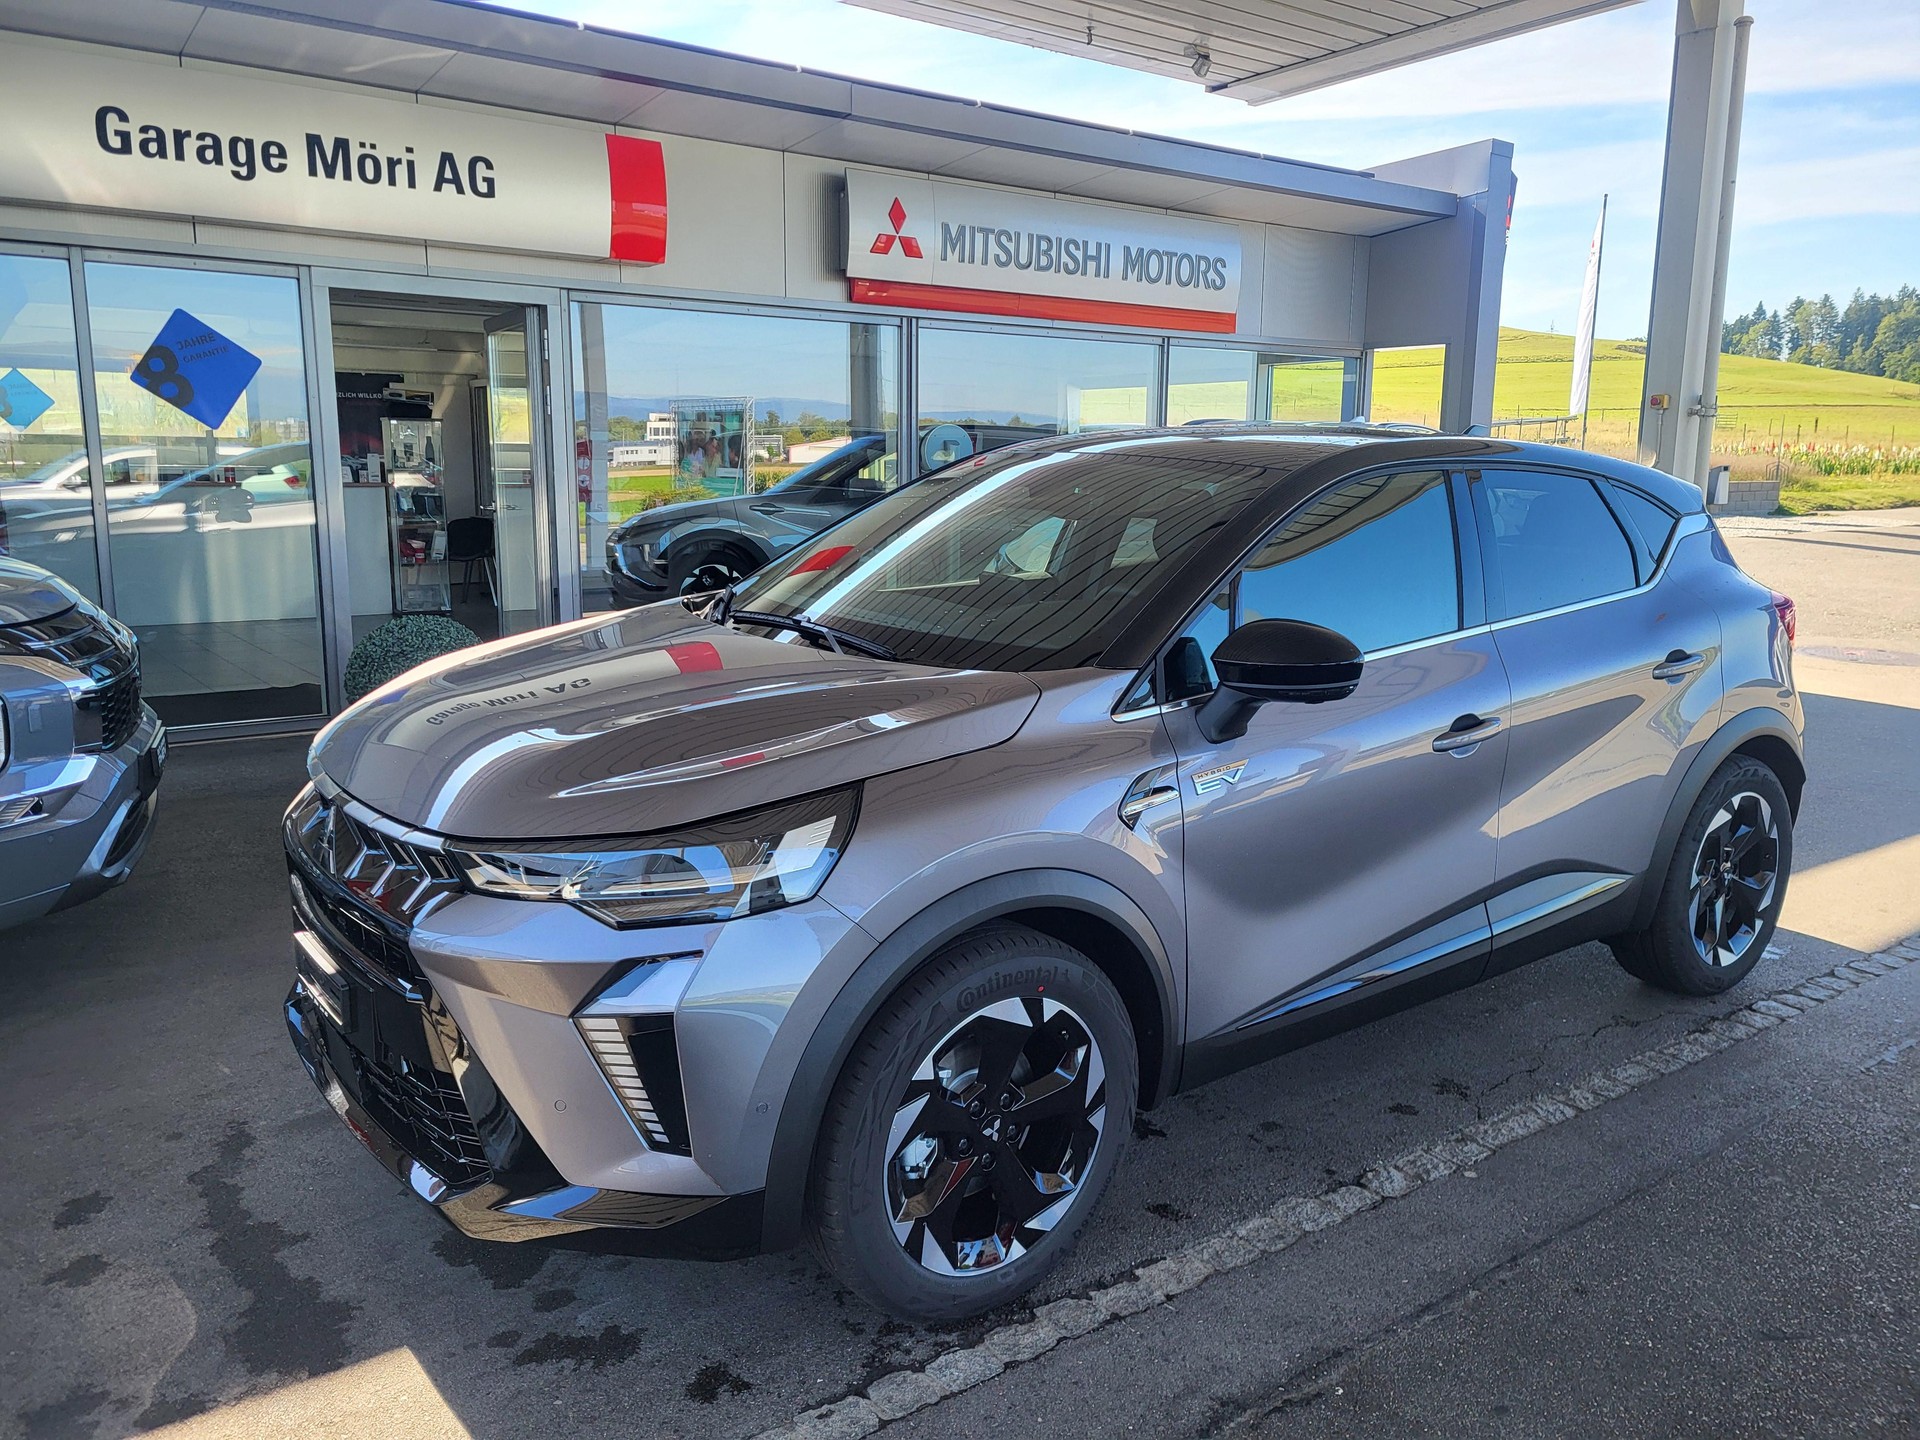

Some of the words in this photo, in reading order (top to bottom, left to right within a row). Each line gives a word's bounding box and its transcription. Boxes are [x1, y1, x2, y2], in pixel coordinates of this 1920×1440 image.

[95, 106, 288, 181] Garage
[305, 133, 417, 190] Möri
[433, 152, 497, 199] AG
[940, 222, 1111, 279] MITSUBISHI
[1122, 245, 1227, 290] MOTORS
[177, 332, 216, 350] JAHRE
[138, 345, 195, 409] 8
[957, 966, 1058, 1012] Continental
